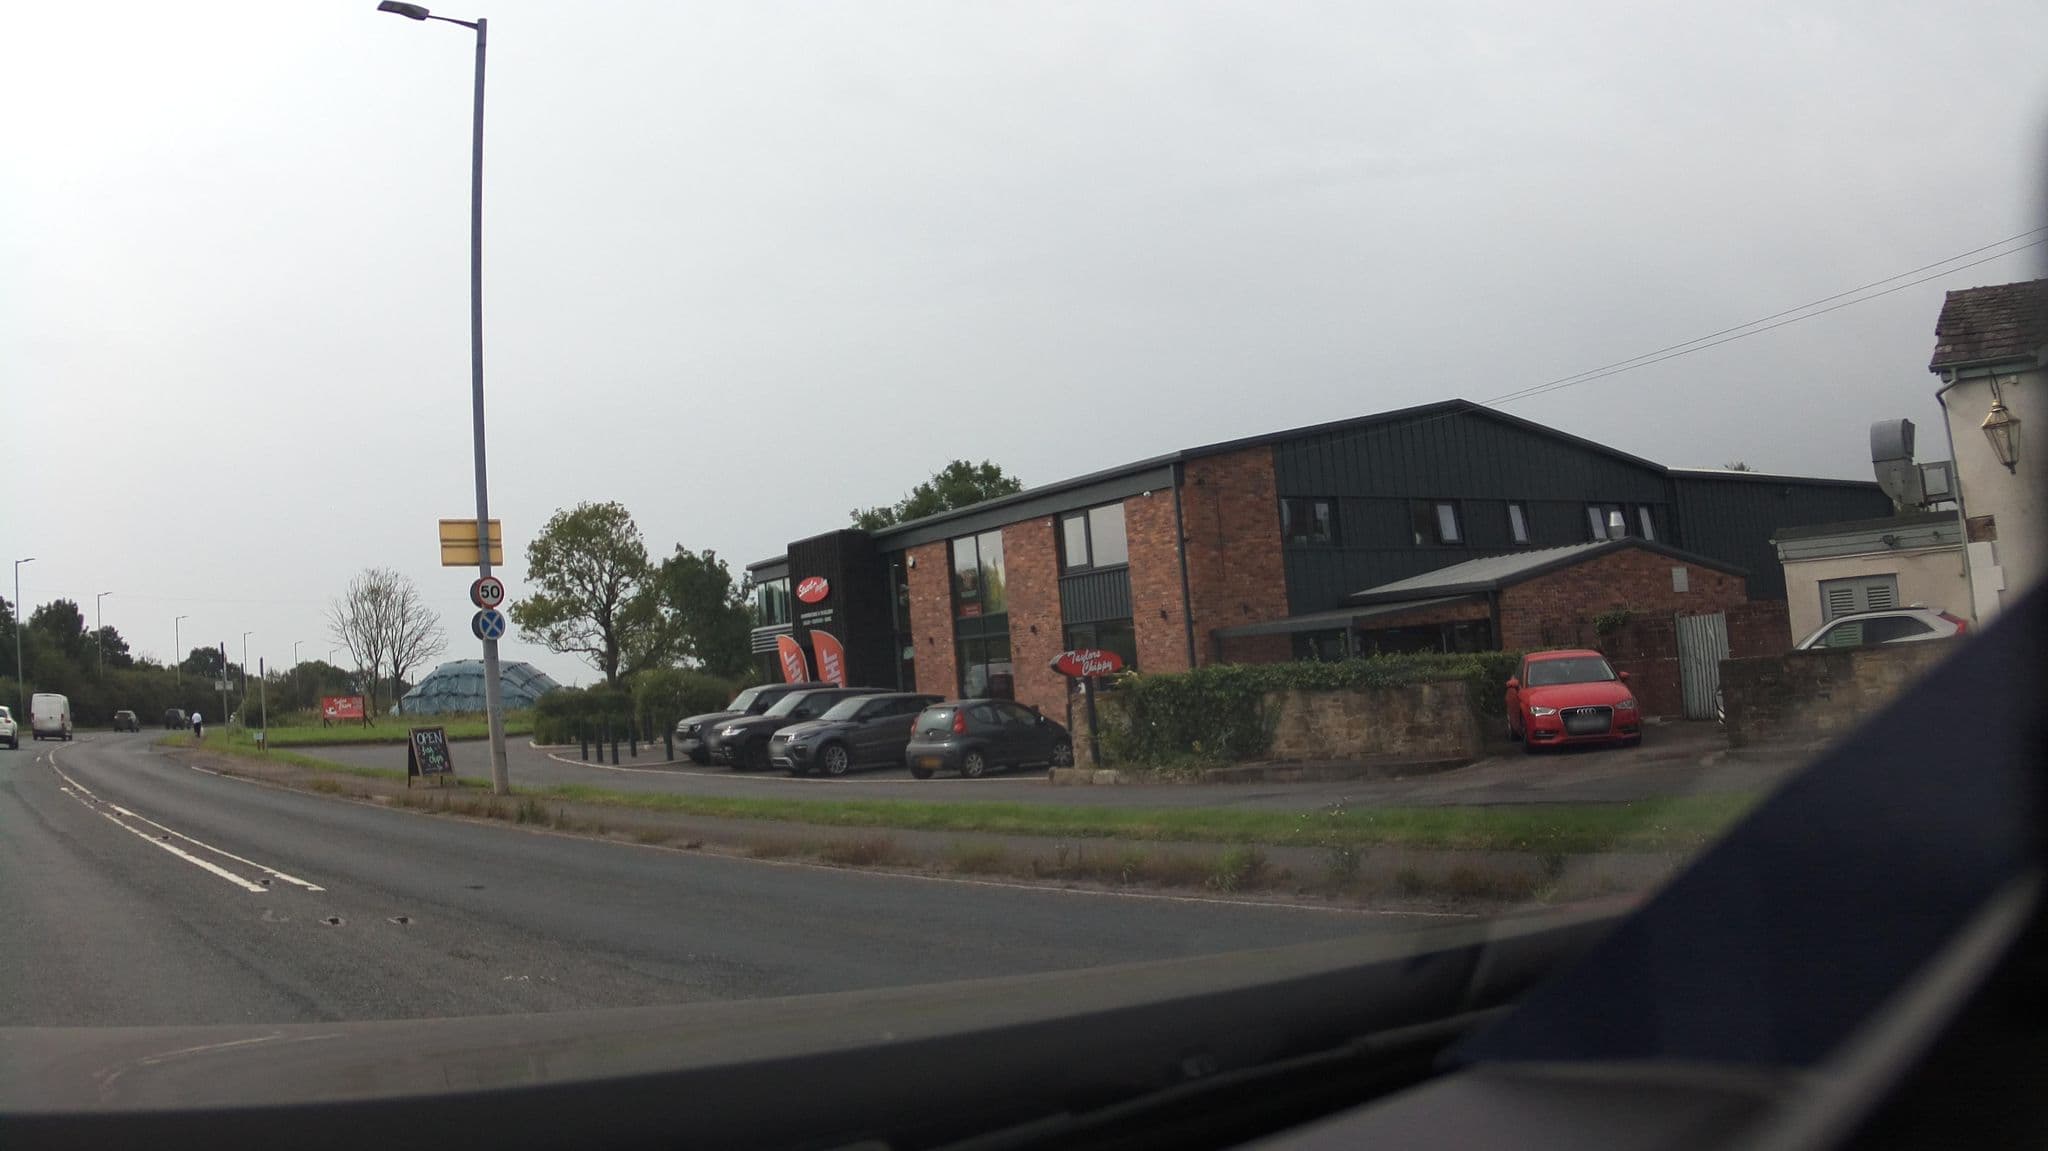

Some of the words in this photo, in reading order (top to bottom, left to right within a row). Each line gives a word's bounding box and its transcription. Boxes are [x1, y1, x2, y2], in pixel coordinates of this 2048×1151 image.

[480, 585, 500, 599] 50
[1081, 660, 1113, 676] Chippy
[416, 730, 443, 745] OPEN
